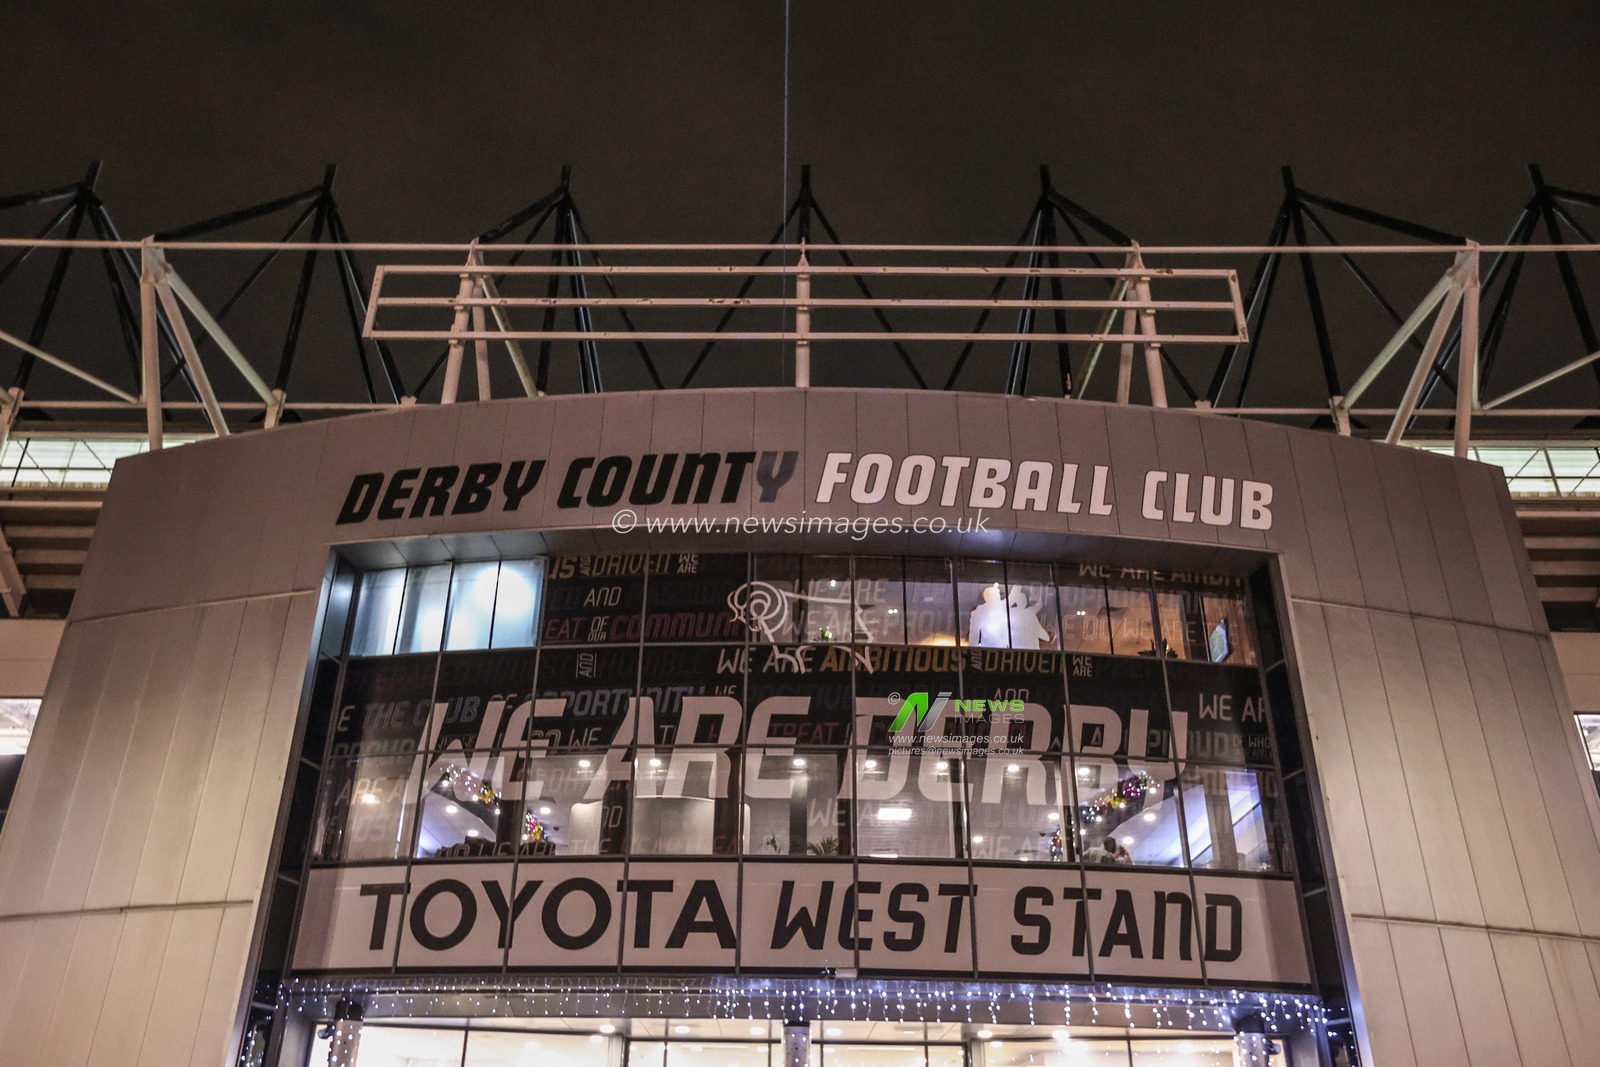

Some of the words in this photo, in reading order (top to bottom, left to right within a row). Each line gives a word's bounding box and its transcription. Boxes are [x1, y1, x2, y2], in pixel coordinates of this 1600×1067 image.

[336, 459, 546, 525] DERBY
[556, 450, 799, 508] COUNTY
[816, 452, 1114, 516] FOOTBALL
[1141, 469, 1273, 531] CLUB
[584, 586, 622, 609] AND
[590, 615, 610, 633] OF
[716, 648, 757, 677] WE
[984, 650, 1065, 674] DRIVEN
[1072, 666, 1093, 678] ARE
[363, 702, 410, 729] THE
[413, 694, 481, 725] CUB
[1199, 692, 1233, 721] WE
[405, 695, 568, 805] WE
[583, 695, 812, 800] ARE
[838, 696, 1189, 811] DERBY
[360, 877, 737, 951] TOYOTA
[770, 880, 978, 953] WEST
[1010, 886, 1243, 962] STAND
